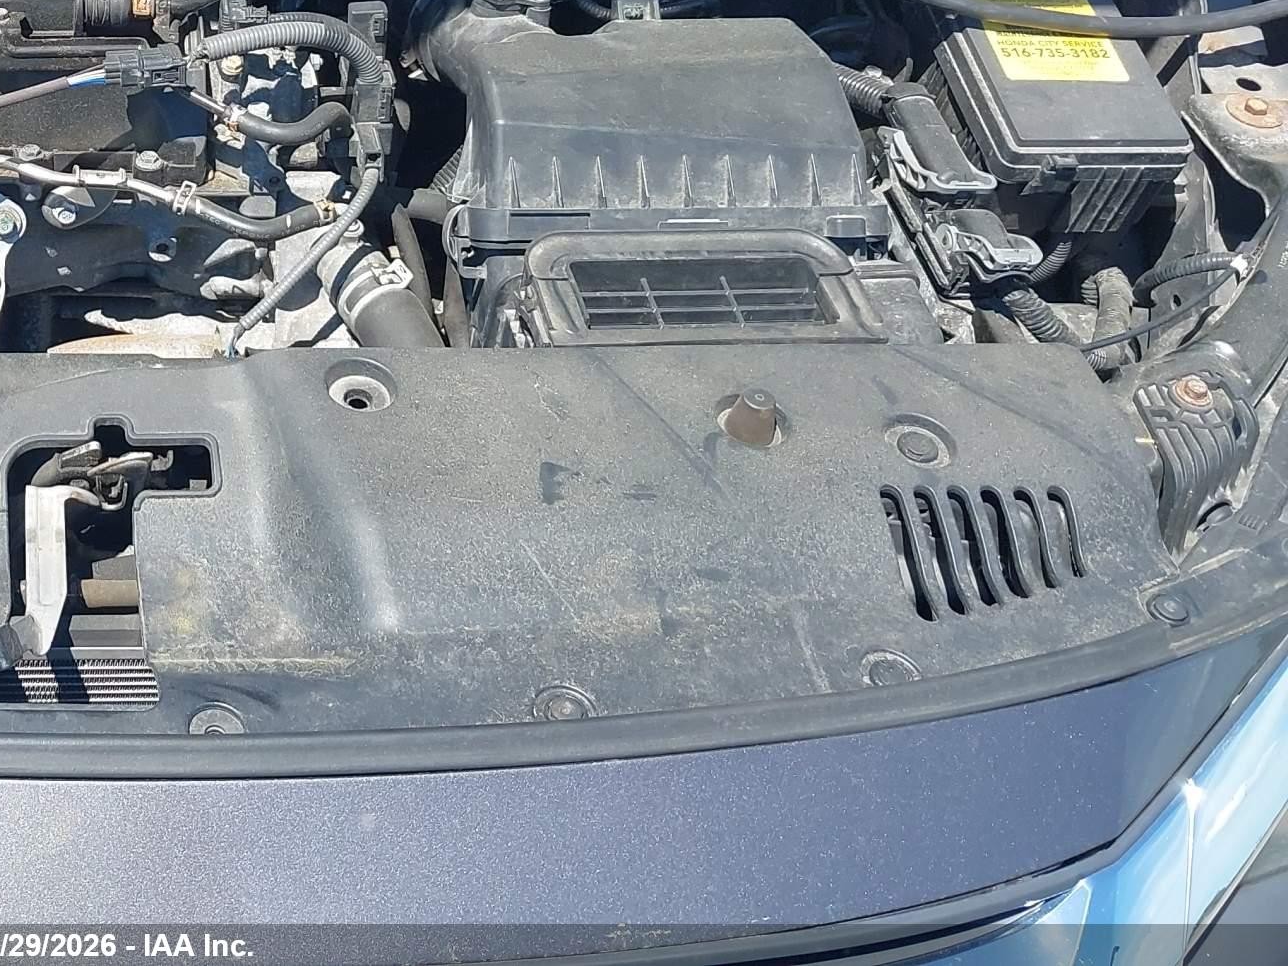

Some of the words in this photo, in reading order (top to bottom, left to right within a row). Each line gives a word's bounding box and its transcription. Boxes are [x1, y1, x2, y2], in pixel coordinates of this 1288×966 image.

[997, 39, 1034, 47] HONDA
[1063, 40, 1104, 48] SERVICE
[1001, 47, 1110, 59] 516-735-3182
